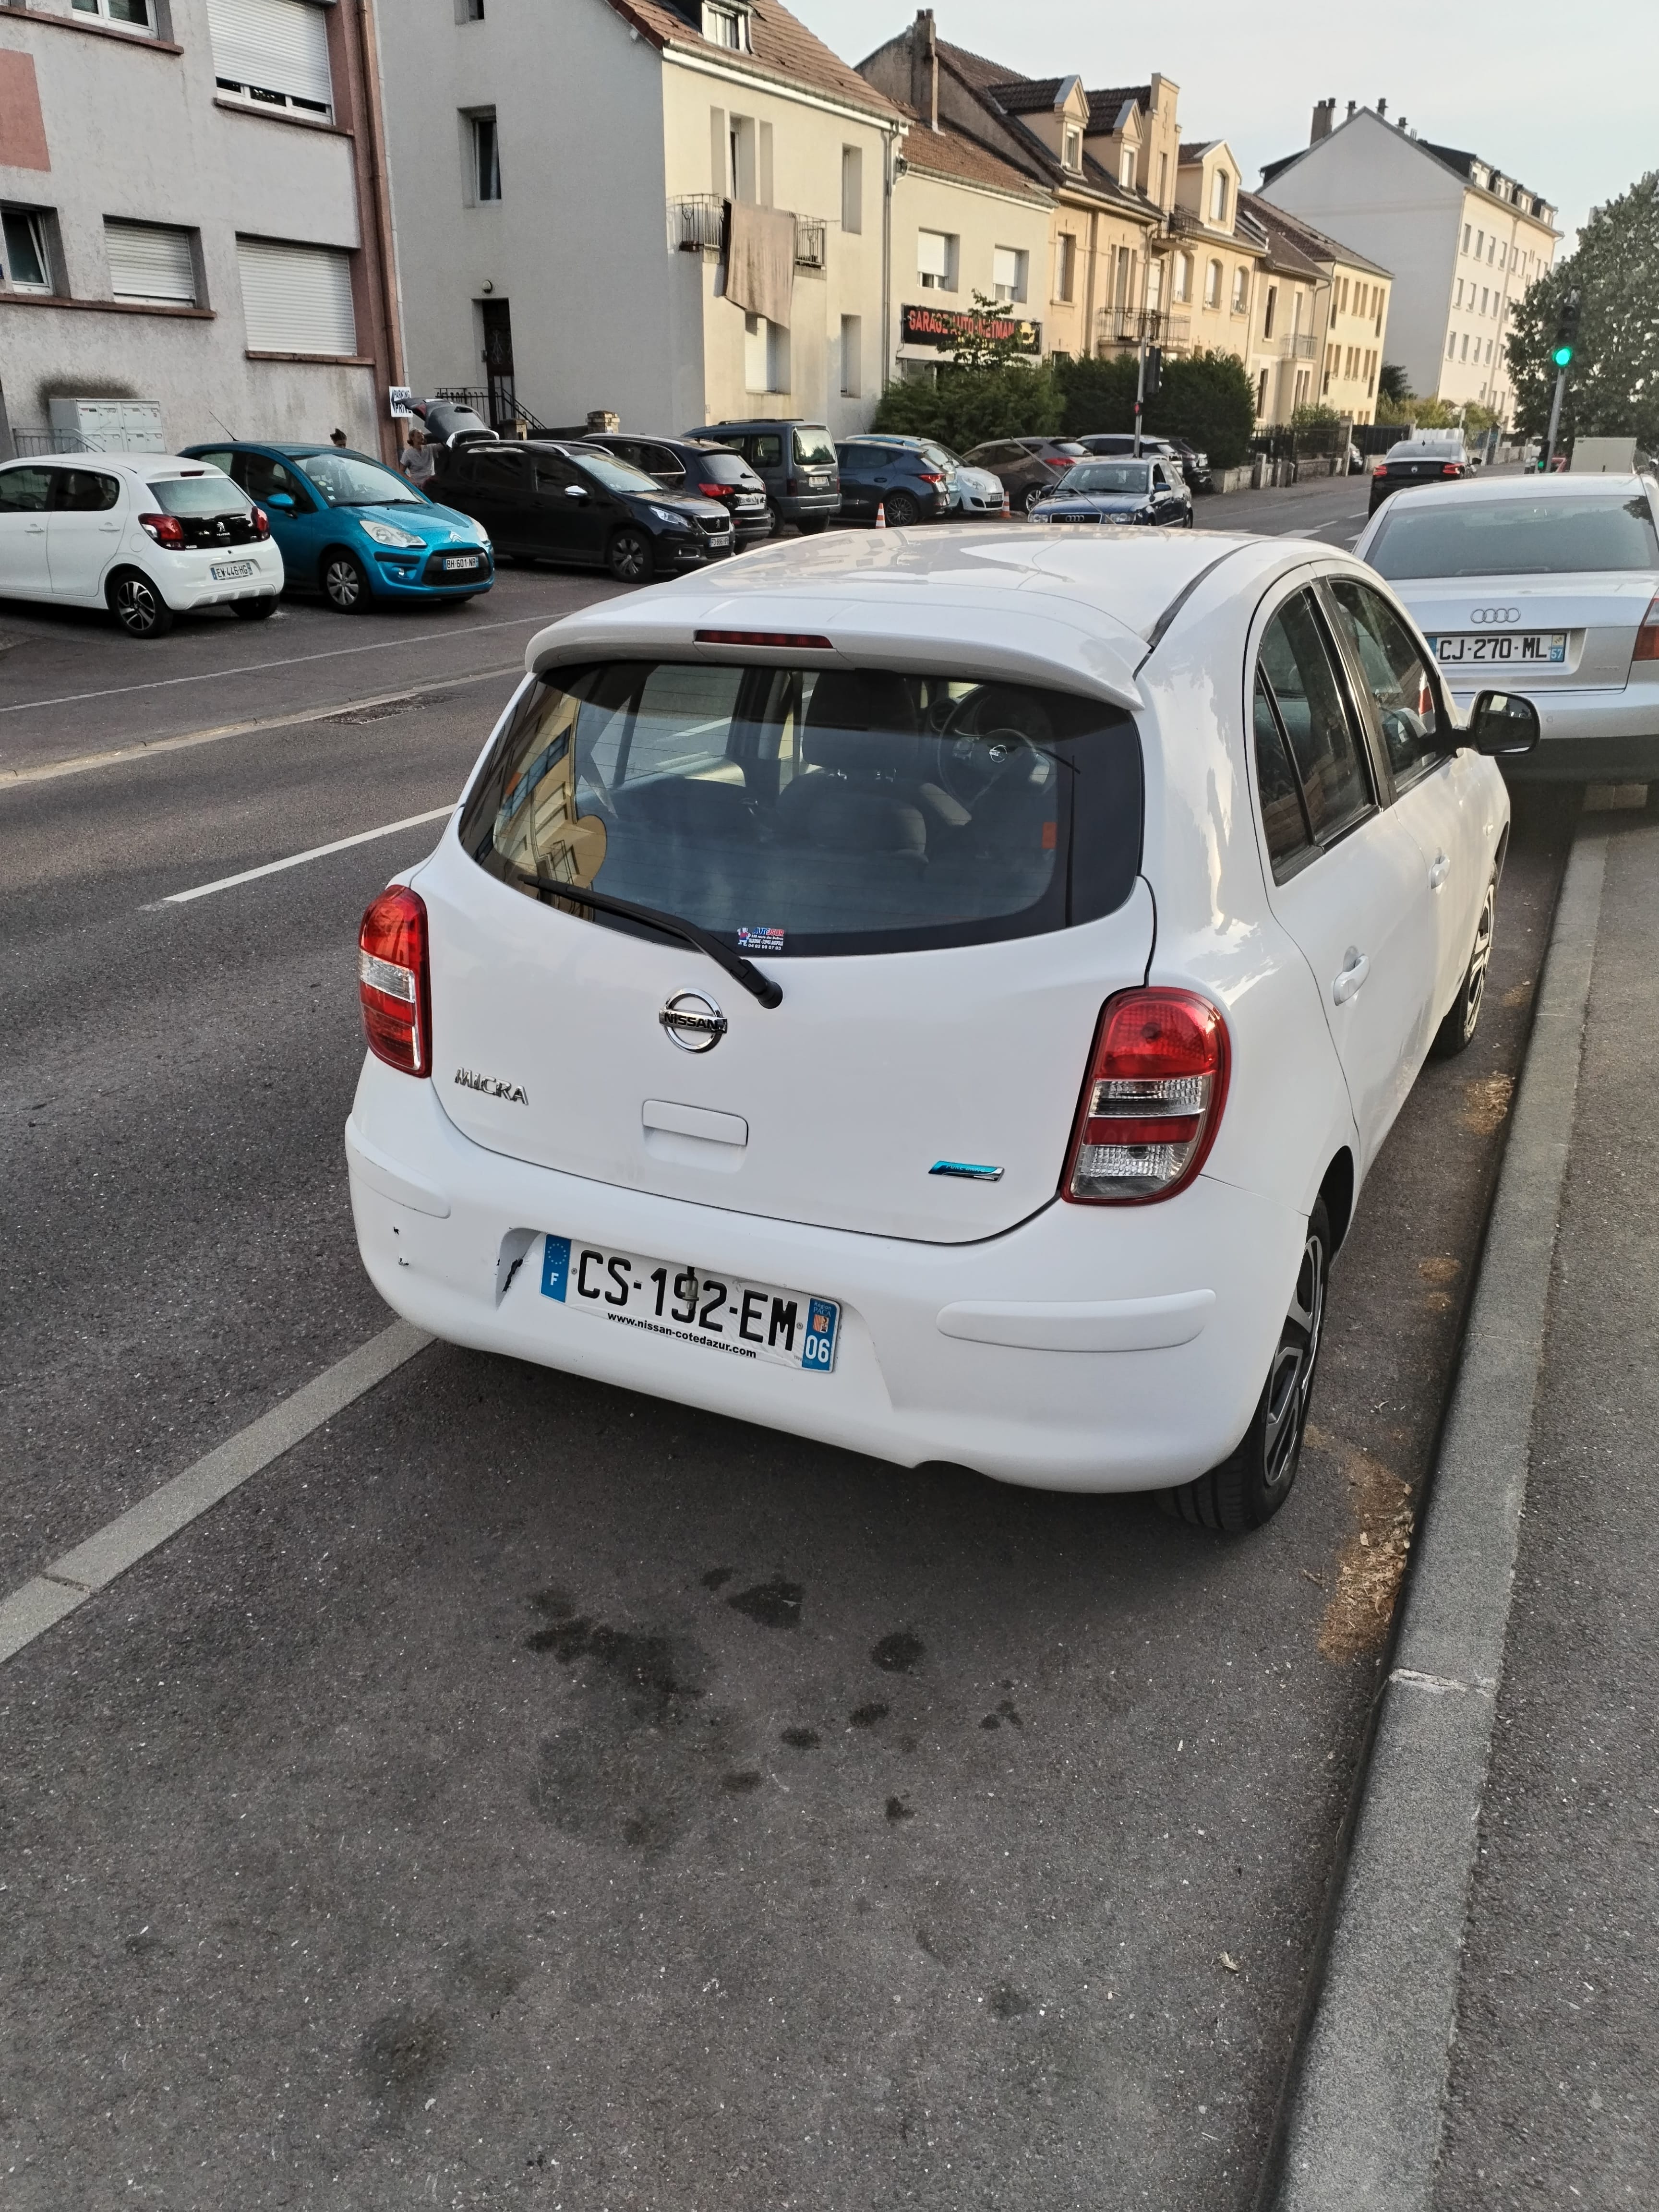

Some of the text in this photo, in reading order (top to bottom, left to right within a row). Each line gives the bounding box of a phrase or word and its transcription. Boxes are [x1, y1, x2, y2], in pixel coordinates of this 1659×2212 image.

[394, 390, 410, 399] PARKING
[1440, 637, 1547, 660] CJ-270-ML
[1551, 649, 1563, 659] 57
[752, 927, 784, 937] AUTOSUR
[664, 1012, 718, 1029] NISSAN
[455, 1067, 529, 1106] MICRA
[550, 1273, 559, 1286] F
[577, 1250, 798, 1351] CS-192-EM
[814, 1301, 831, 1310] Région
[813, 1307, 831, 1318] PACA
[608, 1312, 757, 1358] www.nissan-cotedazur.com
[805, 1335, 830, 1363] 06
